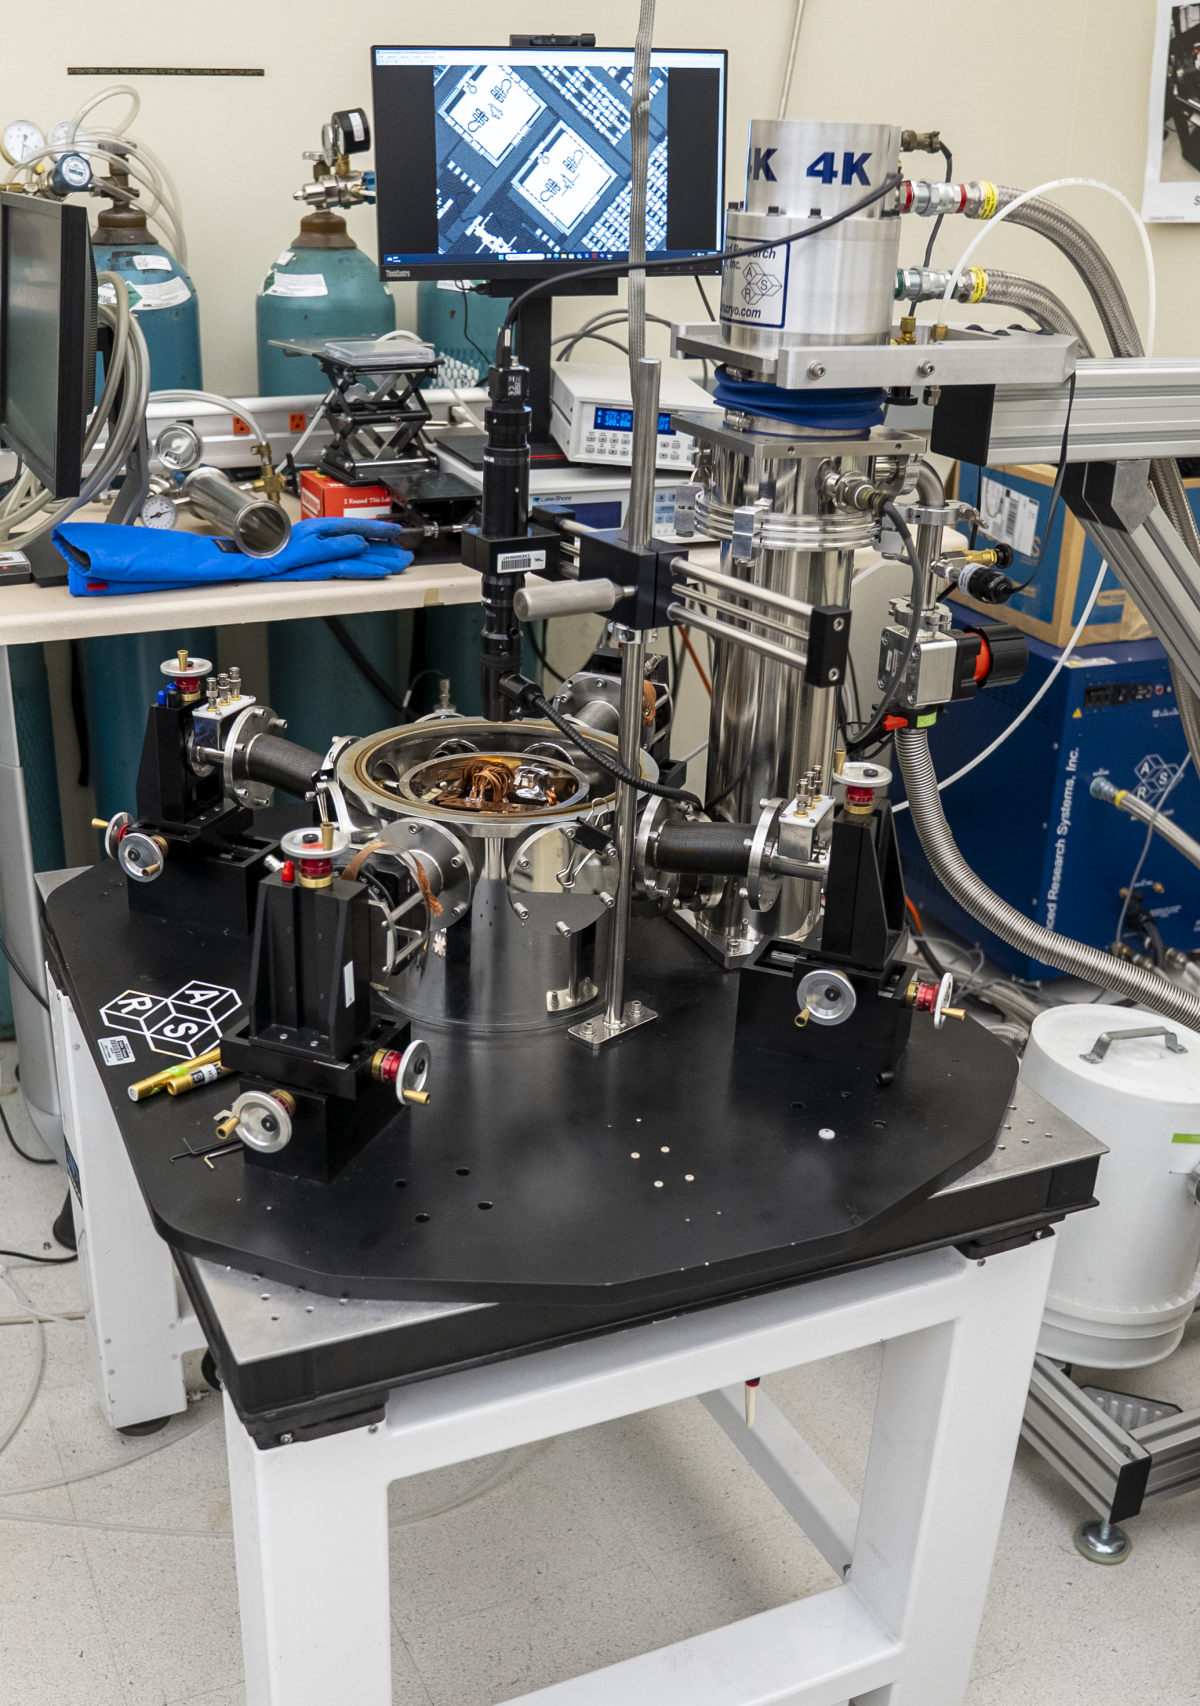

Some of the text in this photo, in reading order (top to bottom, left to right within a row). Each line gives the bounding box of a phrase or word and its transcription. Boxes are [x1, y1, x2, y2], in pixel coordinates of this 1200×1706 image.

[747, 147, 777, 182] K
[806, 151, 873, 186] 4K
[746, 267, 752, 278] A
[760, 280, 768, 291] S
[744, 288, 751, 300] R
[1065, 746, 1080, 772] Inc.
[1140, 762, 1150, 775] A
[1158, 772, 1168, 785] S
[1136, 786, 1147, 799] R
[1056, 775, 1077, 836] Systems,
[1047, 838, 1066, 900] Research
[117, 996, 153, 1014] R
[184, 989, 221, 1005] A
[162, 1022, 199, 1038] S
